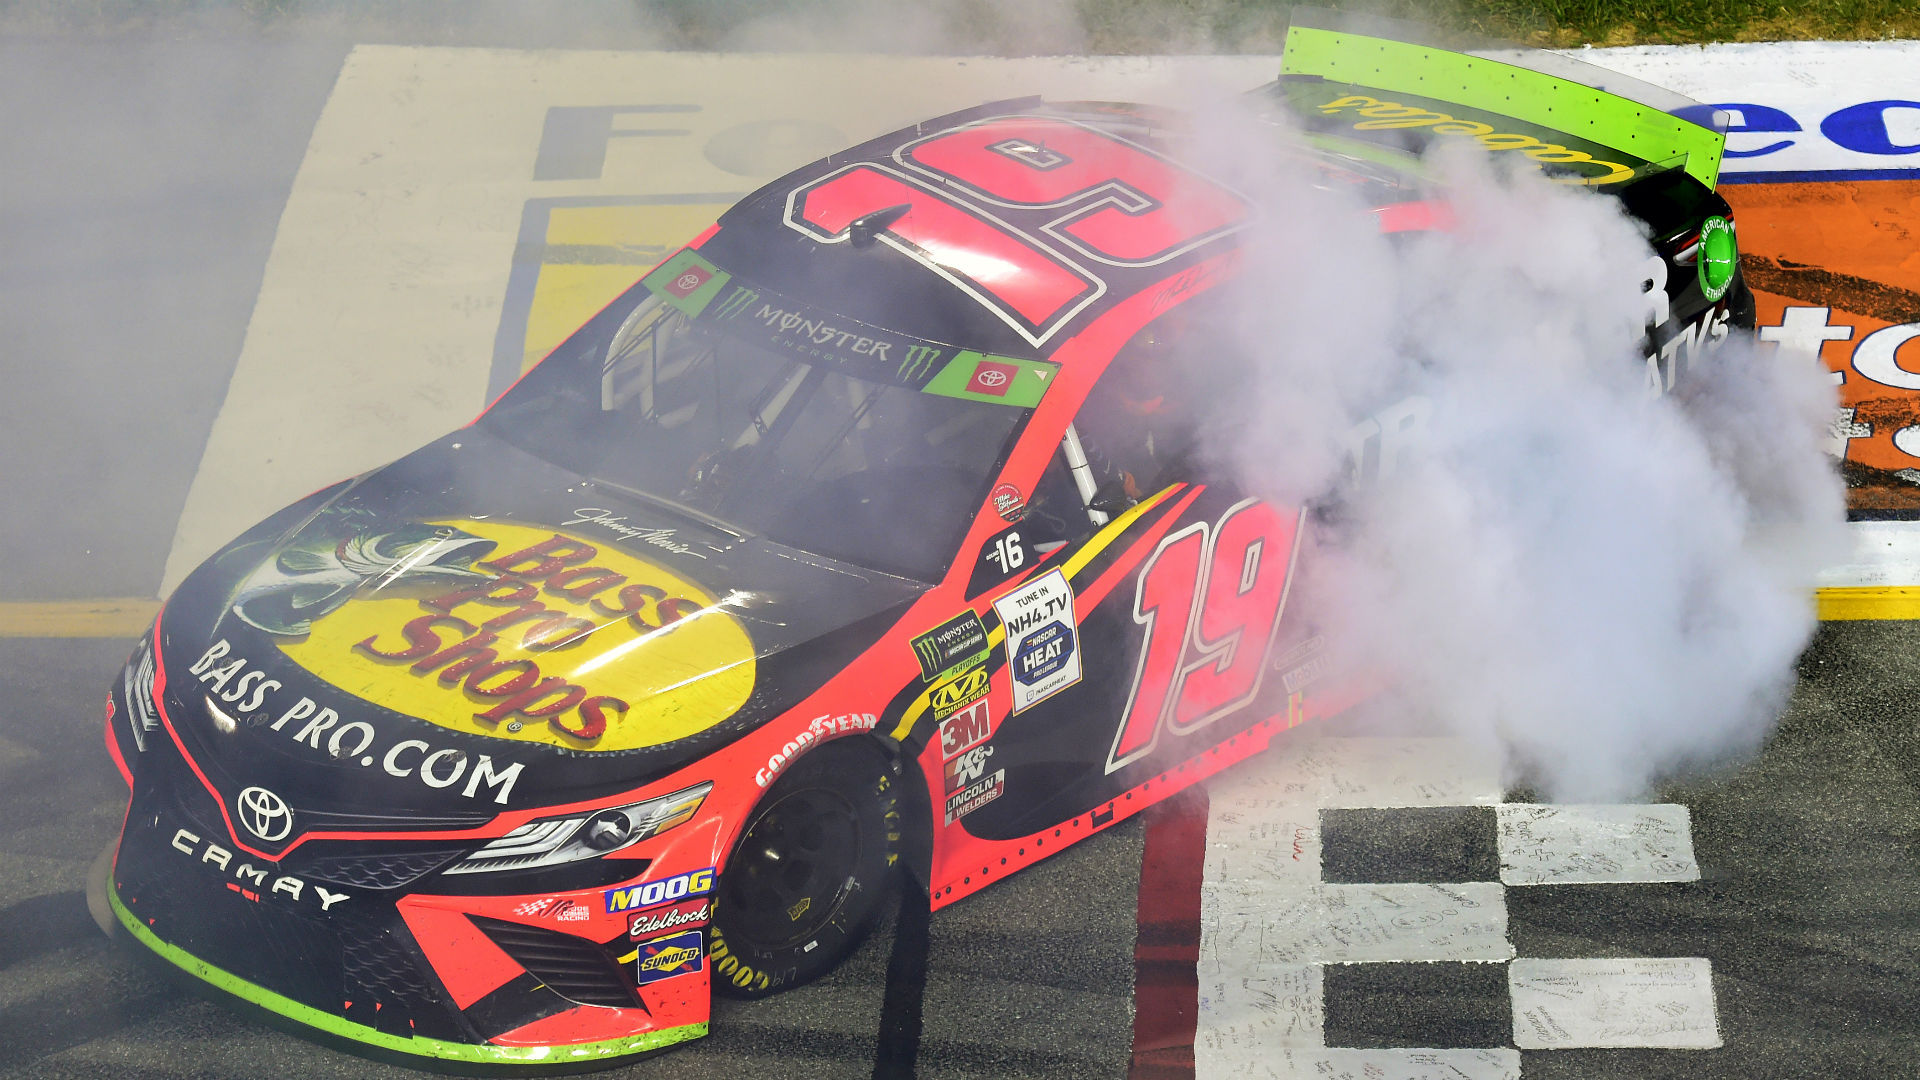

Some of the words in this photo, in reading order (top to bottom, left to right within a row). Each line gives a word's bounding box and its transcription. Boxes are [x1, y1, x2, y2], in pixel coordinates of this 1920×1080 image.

[1700, 219, 1729, 250] AMERICAN
[1706, 274, 1733, 298] ETHANOL
[995, 531, 1024, 574] 16
[477, 533, 704, 633] Bass
[1015, 591, 1039, 609] TUNE
[1038, 585, 1050, 599] IN
[418, 573, 597, 652] Pro
[1007, 592, 1068, 638] NH4.TV
[1022, 636, 1064, 673] HEAT
[1032, 626, 1057, 648] NASCAR
[1104, 496, 1307, 776] 19
[351, 614, 631, 742] Shops
[189, 638, 282, 713] BASS
[270, 697, 526, 805] PRO.COM
[934, 699, 970, 721] MECHANIX
[969, 683, 991, 704] WEAR
[943, 701, 989, 755] 3M
[755, 713, 877, 788] GOODYEAR
[947, 776, 994, 812] LINCOLN
[955, 789, 998, 818] WELDERS
[610, 869, 713, 912] MOOG
[630, 906, 709, 937] Edelbrock
[643, 947, 698, 971] SUNOCO
